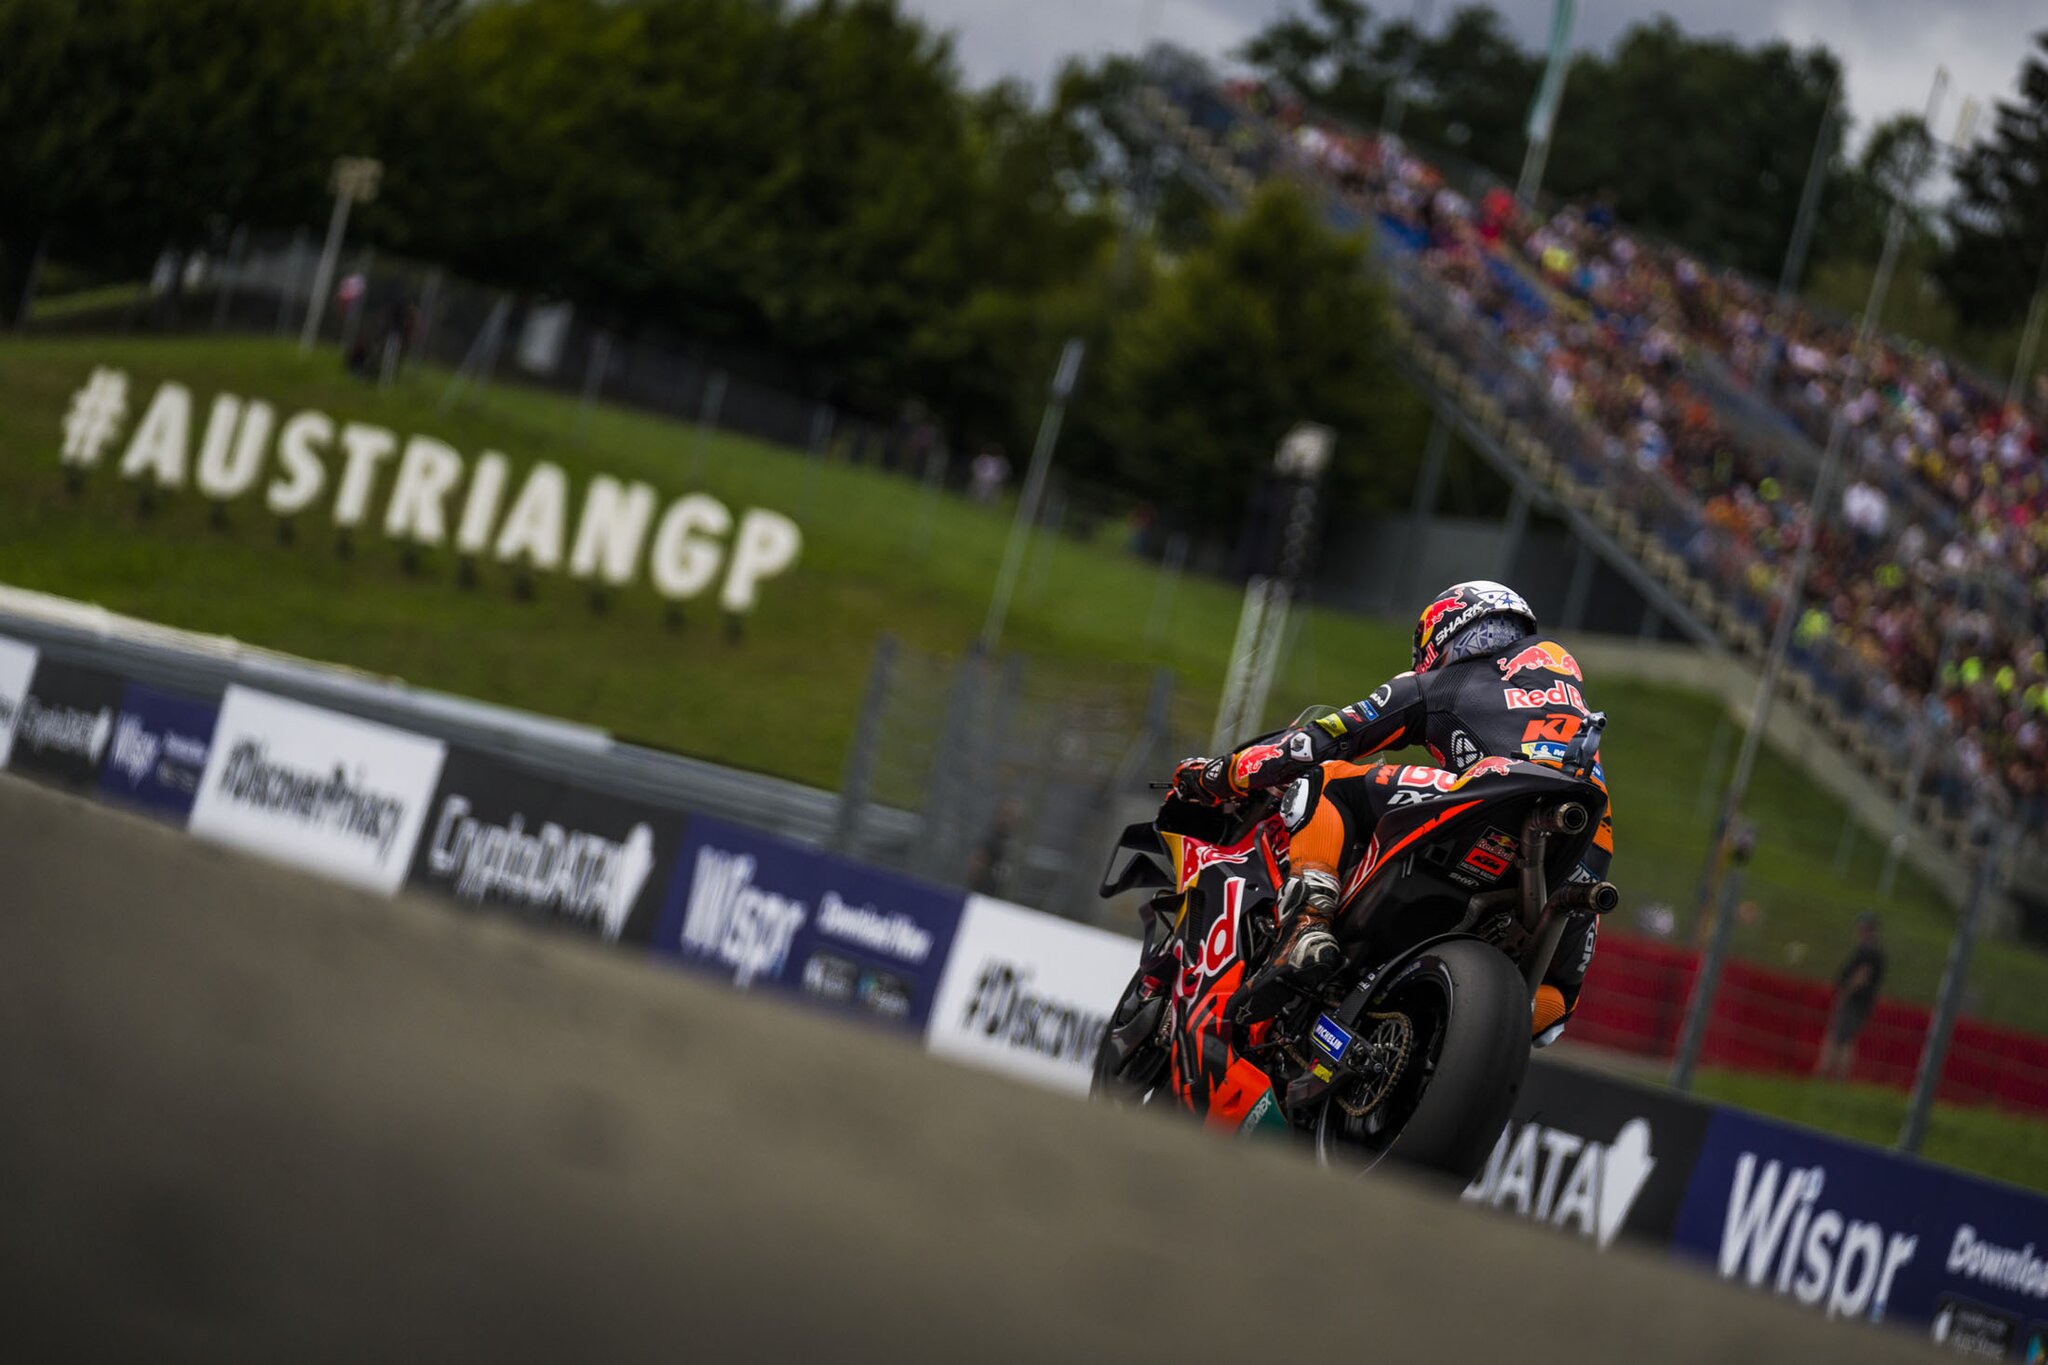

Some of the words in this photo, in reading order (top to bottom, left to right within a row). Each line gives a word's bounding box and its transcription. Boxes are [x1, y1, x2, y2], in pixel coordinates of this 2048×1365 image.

[60, 365, 803, 613] #AUSTRIANGP
[1436, 601, 1484, 646] SHARK
[1504, 680, 1569, 710] Red
[1521, 713, 1582, 743] KT
[1315, 1023, 1344, 1051] MICHELIN
[1718, 1151, 1918, 1322] Wispr
